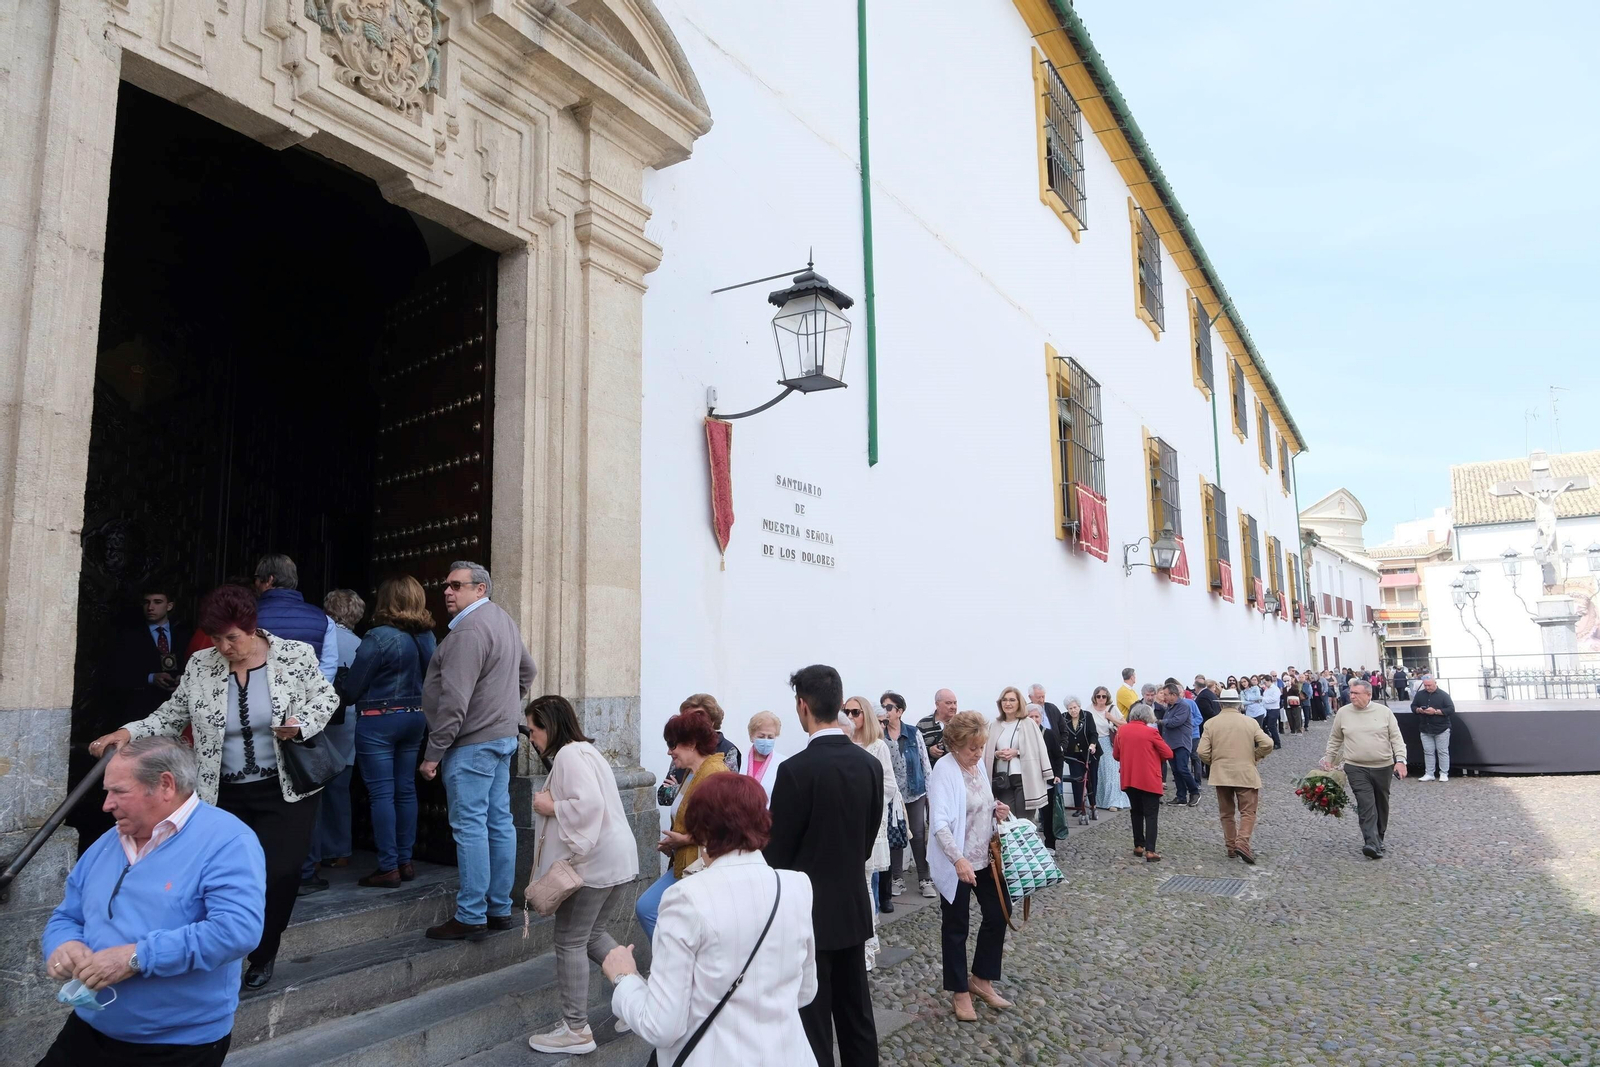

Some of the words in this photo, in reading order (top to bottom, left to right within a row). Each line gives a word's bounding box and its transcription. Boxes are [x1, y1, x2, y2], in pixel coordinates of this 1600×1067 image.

[776, 475, 822, 496] SANTUARIO
[795, 503, 805, 514] DE
[762, 518, 800, 537] NUESTRA
[805, 528, 834, 545] SEÑORA
[763, 544, 774, 555] DE
[780, 547, 796, 560] LOS
[801, 551, 835, 567] DOLORES
